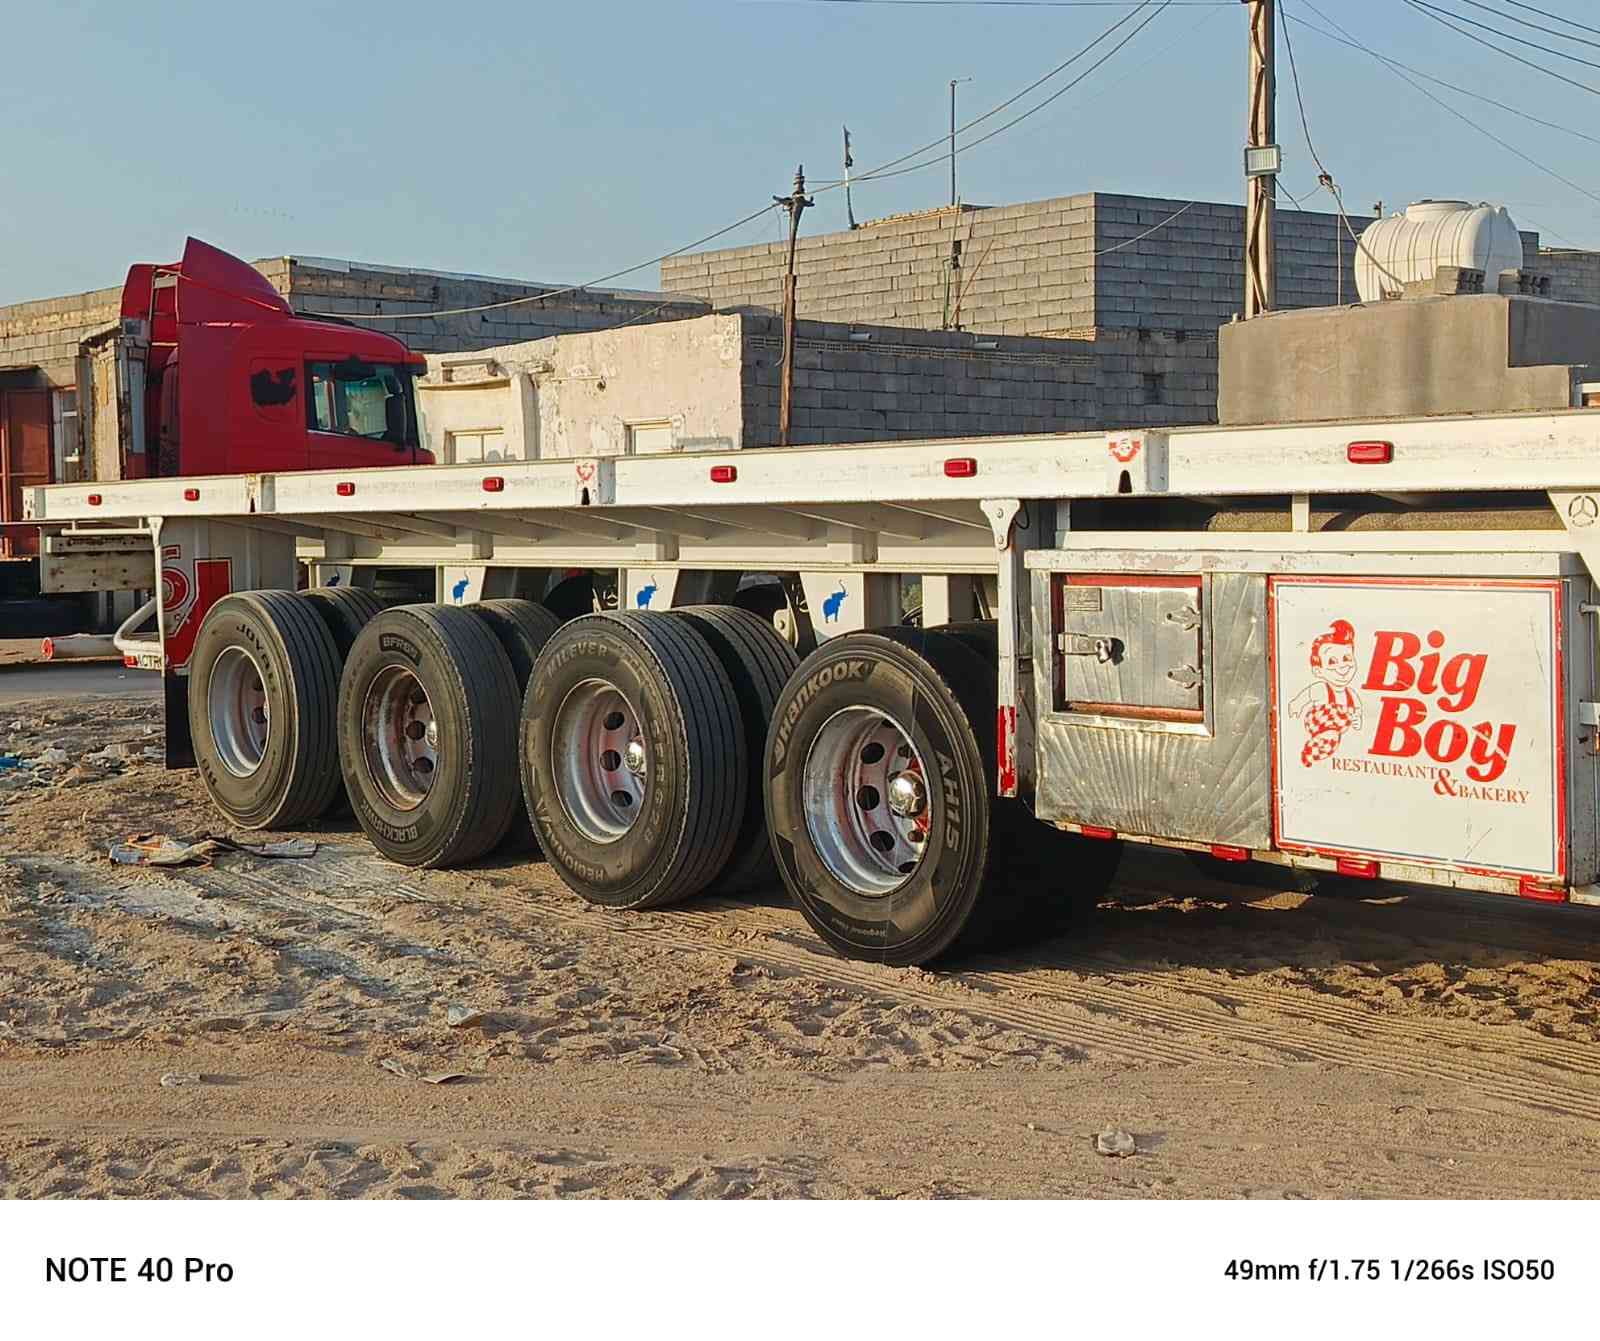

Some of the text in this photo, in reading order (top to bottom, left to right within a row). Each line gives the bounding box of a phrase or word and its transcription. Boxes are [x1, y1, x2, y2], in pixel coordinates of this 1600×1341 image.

[1361, 630, 1487, 713] Big
[1331, 757, 1530, 804] RESTAURANT & BAKERY
[1367, 696, 1517, 783] Boy
